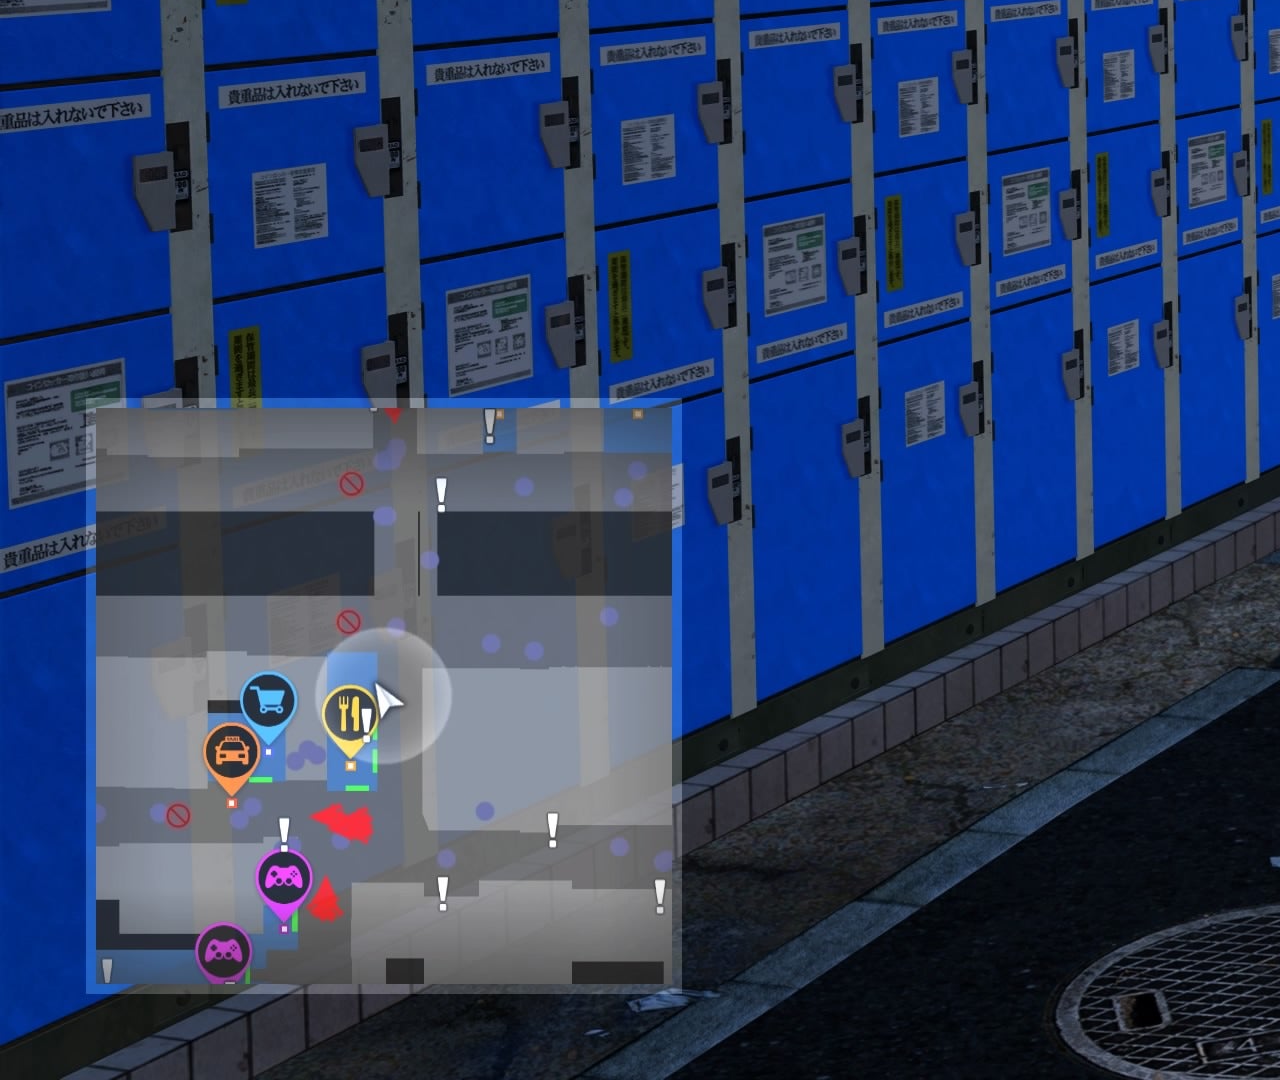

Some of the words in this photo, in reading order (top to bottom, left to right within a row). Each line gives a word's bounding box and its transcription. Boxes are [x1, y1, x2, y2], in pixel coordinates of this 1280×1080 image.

[434, 58, 546, 83] 貴重品は入れないで下さい
[228, 77, 360, 106] 貴重品は入れないで下さい
